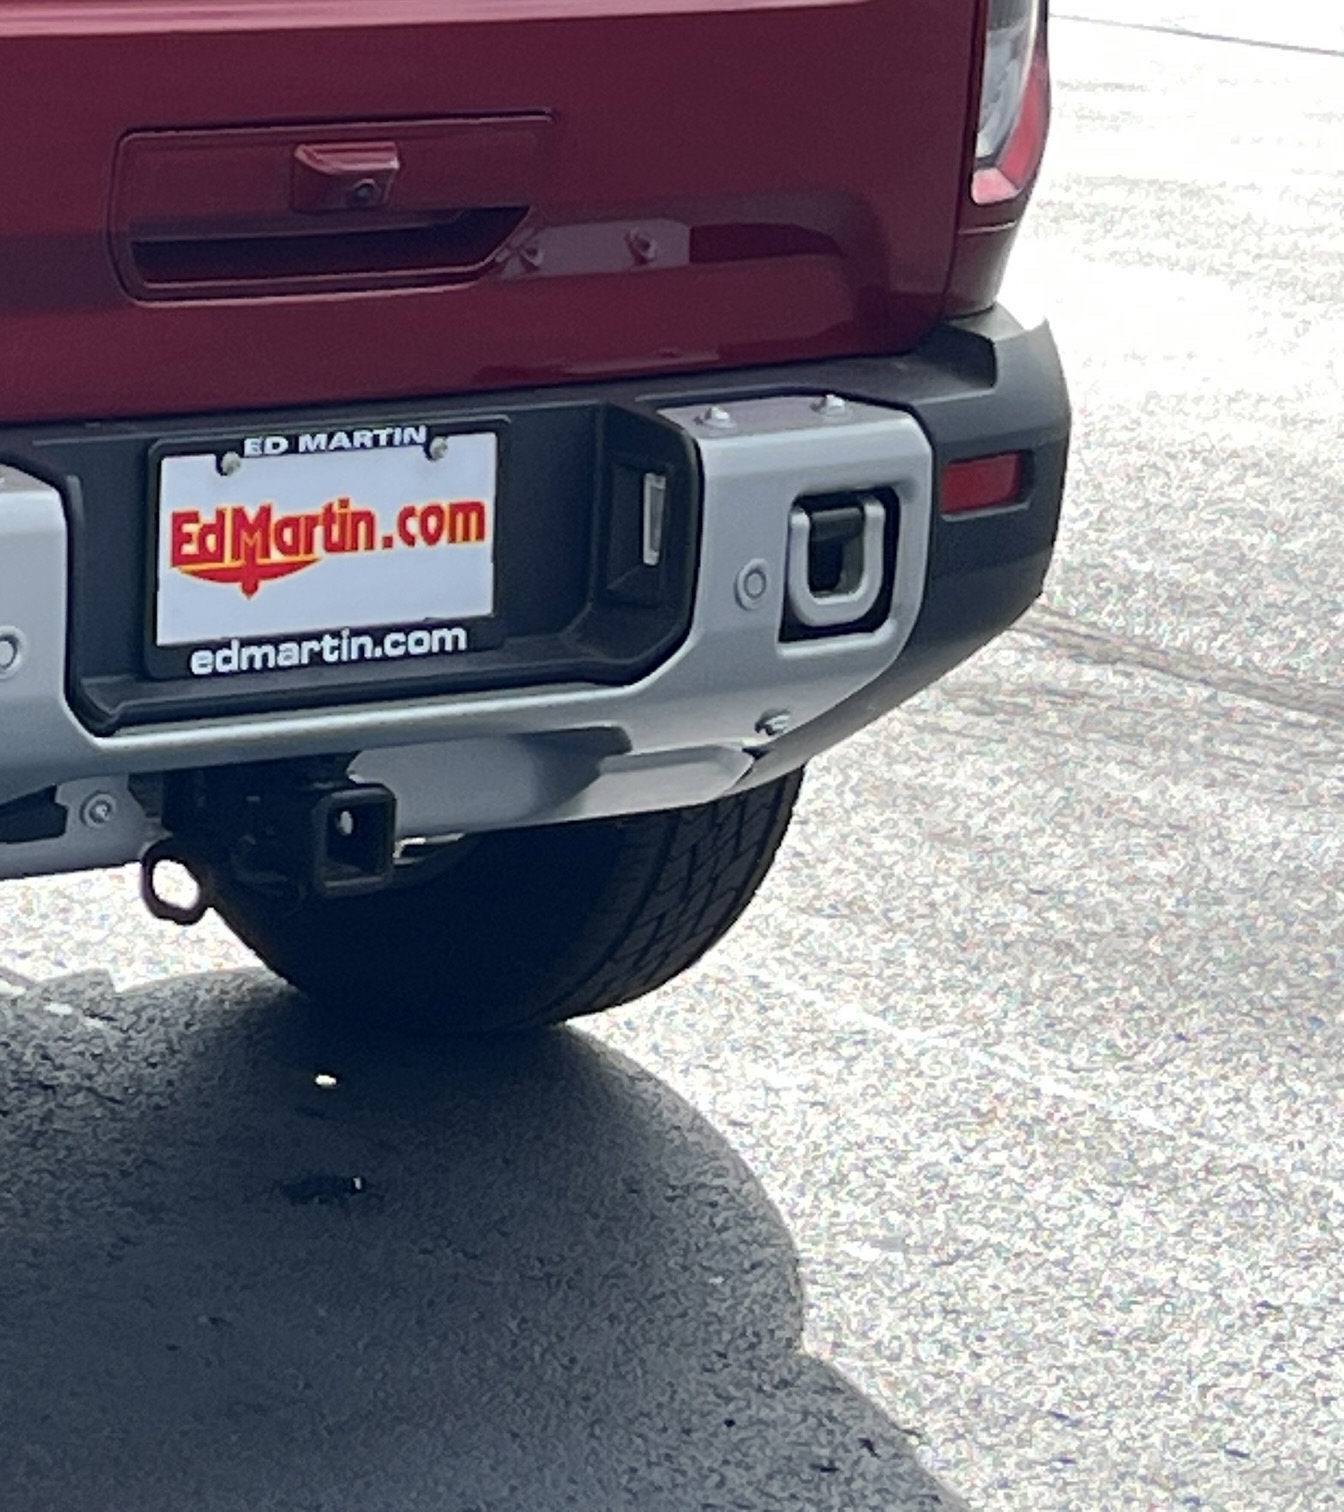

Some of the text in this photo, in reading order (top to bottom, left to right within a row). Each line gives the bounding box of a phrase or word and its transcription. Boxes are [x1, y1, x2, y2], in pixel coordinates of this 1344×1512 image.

[243, 425, 427, 458] ED MARTIN
[190, 626, 467, 675] edmartin.com
